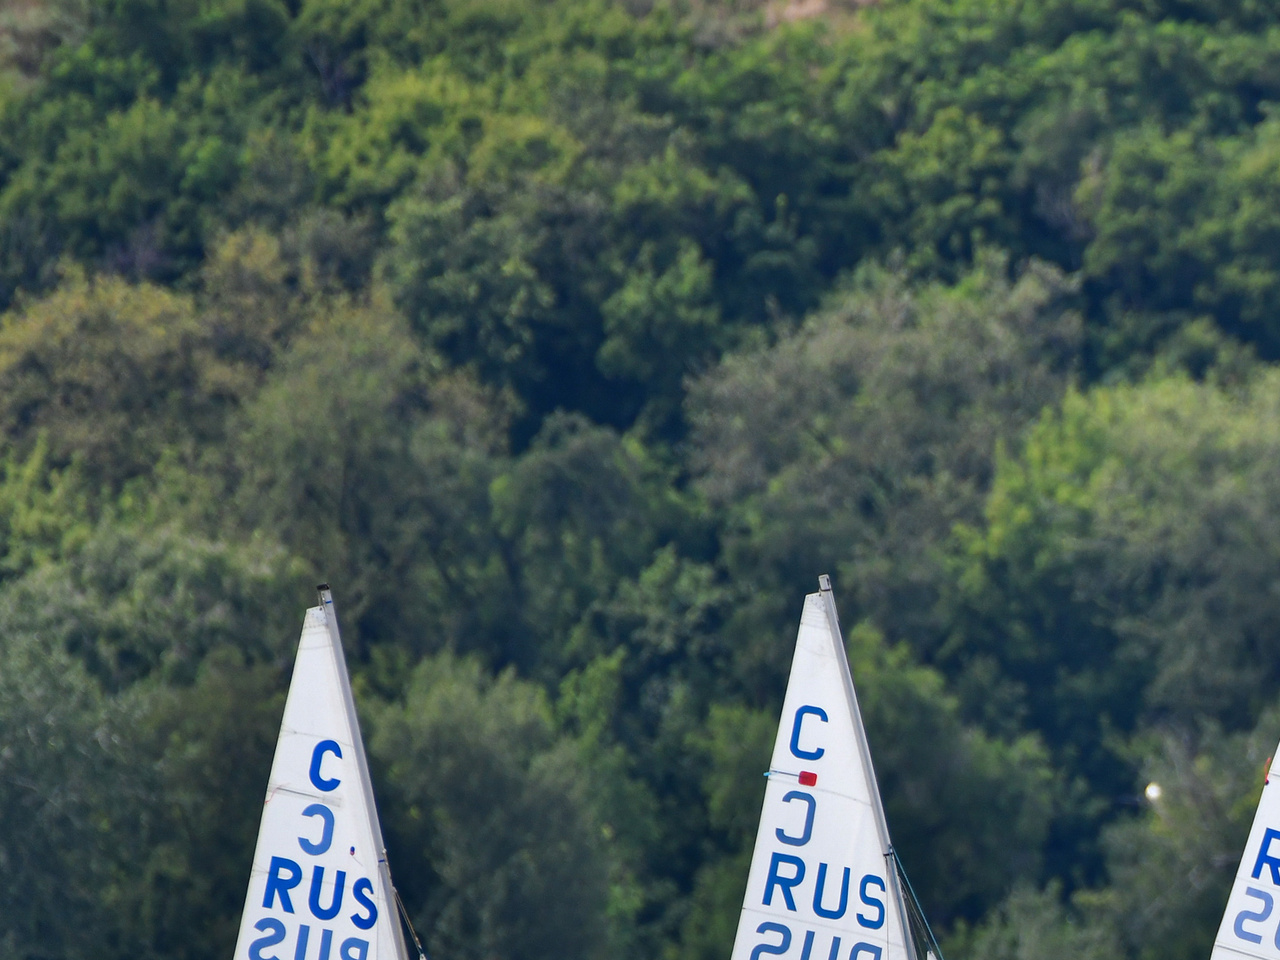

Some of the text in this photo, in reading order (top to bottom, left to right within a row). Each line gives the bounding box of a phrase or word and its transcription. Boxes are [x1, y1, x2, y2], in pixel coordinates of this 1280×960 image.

[309, 739, 343, 792] C
[790, 705, 828, 761] C
[262, 856, 379, 930] RUS
[763, 852, 886, 929] RUS
